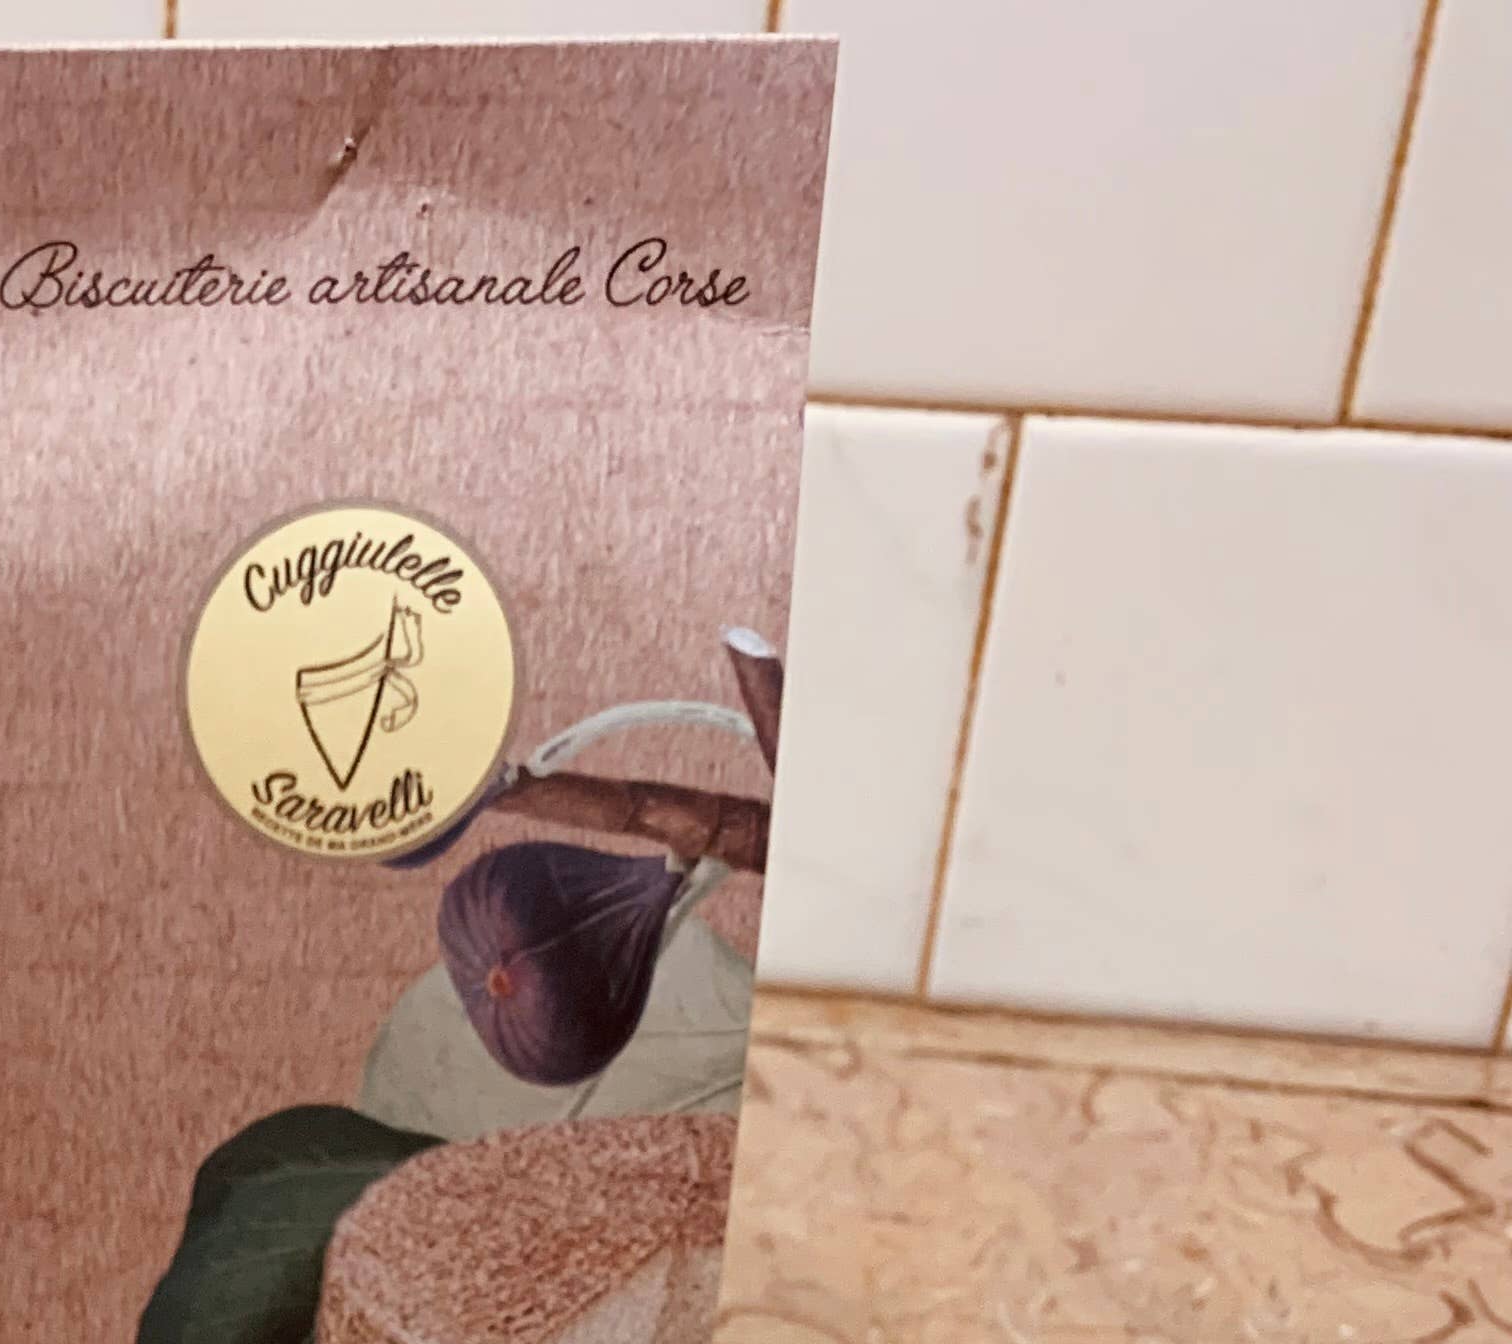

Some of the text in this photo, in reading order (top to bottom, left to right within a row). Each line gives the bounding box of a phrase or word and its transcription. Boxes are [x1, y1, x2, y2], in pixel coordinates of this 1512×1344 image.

[0, 236, 752, 312] Biscuiterie artisanale Corse
[244, 532, 463, 613] Cuggiulelle
[252, 769, 433, 833] Saravelli
